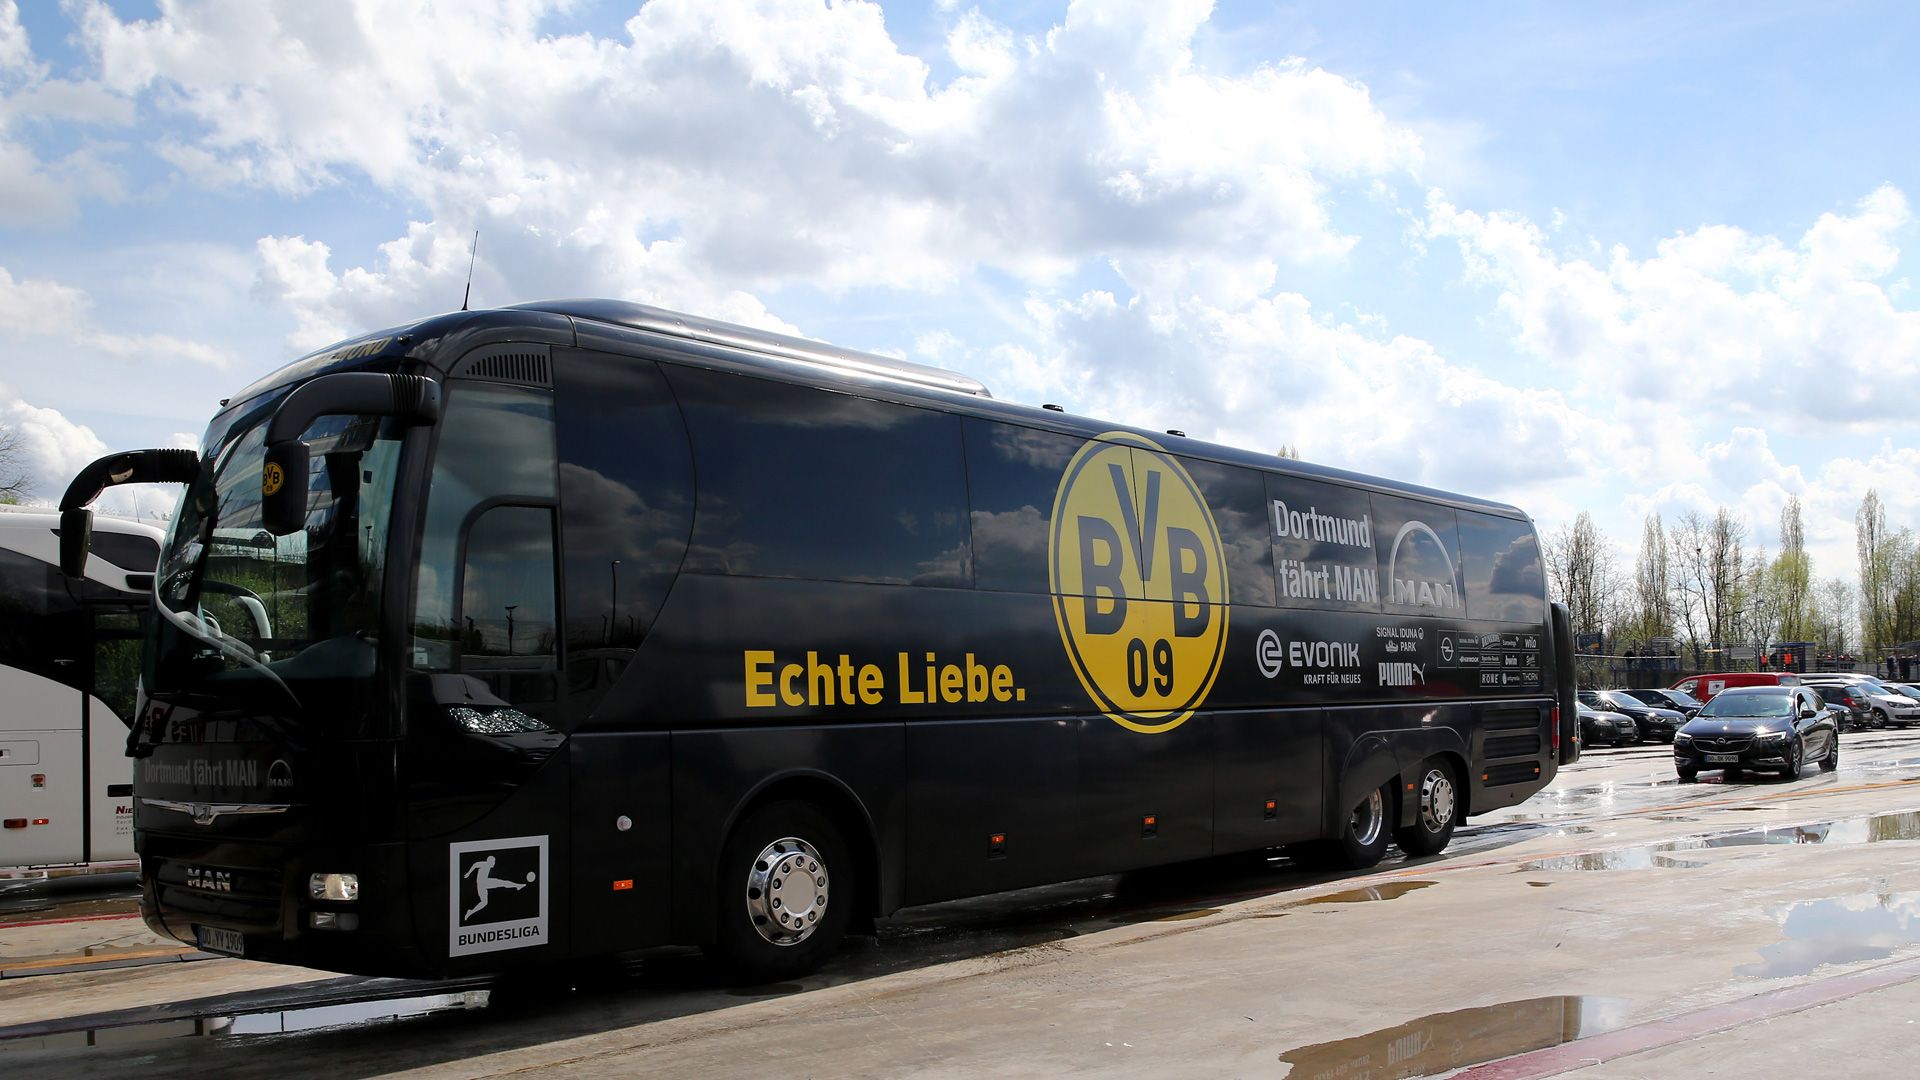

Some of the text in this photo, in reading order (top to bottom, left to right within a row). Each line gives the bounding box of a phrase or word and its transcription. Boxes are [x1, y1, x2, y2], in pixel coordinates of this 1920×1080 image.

[1273, 500, 1371, 548] Dortmund
[1077, 463, 1211, 638] BVB
[1279, 560, 1377, 603] fährt MAN
[1394, 579, 1455, 608] MAN
[1376, 626, 1418, 638] SIGNAL IDUNA
[1289, 641, 1361, 668] EVONIK
[1401, 642, 1417, 652] PARK
[745, 650, 1026, 707] Echte Liebe.
[1127, 637, 1174, 698] 09
[1303, 672, 1361, 684] KRAFT FÜR NEUES
[1378, 662, 1414, 686] PUMA
[1522, 672, 1539, 681] THORN
[144, 759, 257, 787] Dortmund fährt MAN
[187, 868, 231, 893] MAN
[458, 925, 540, 946] BUNDESLIGA
